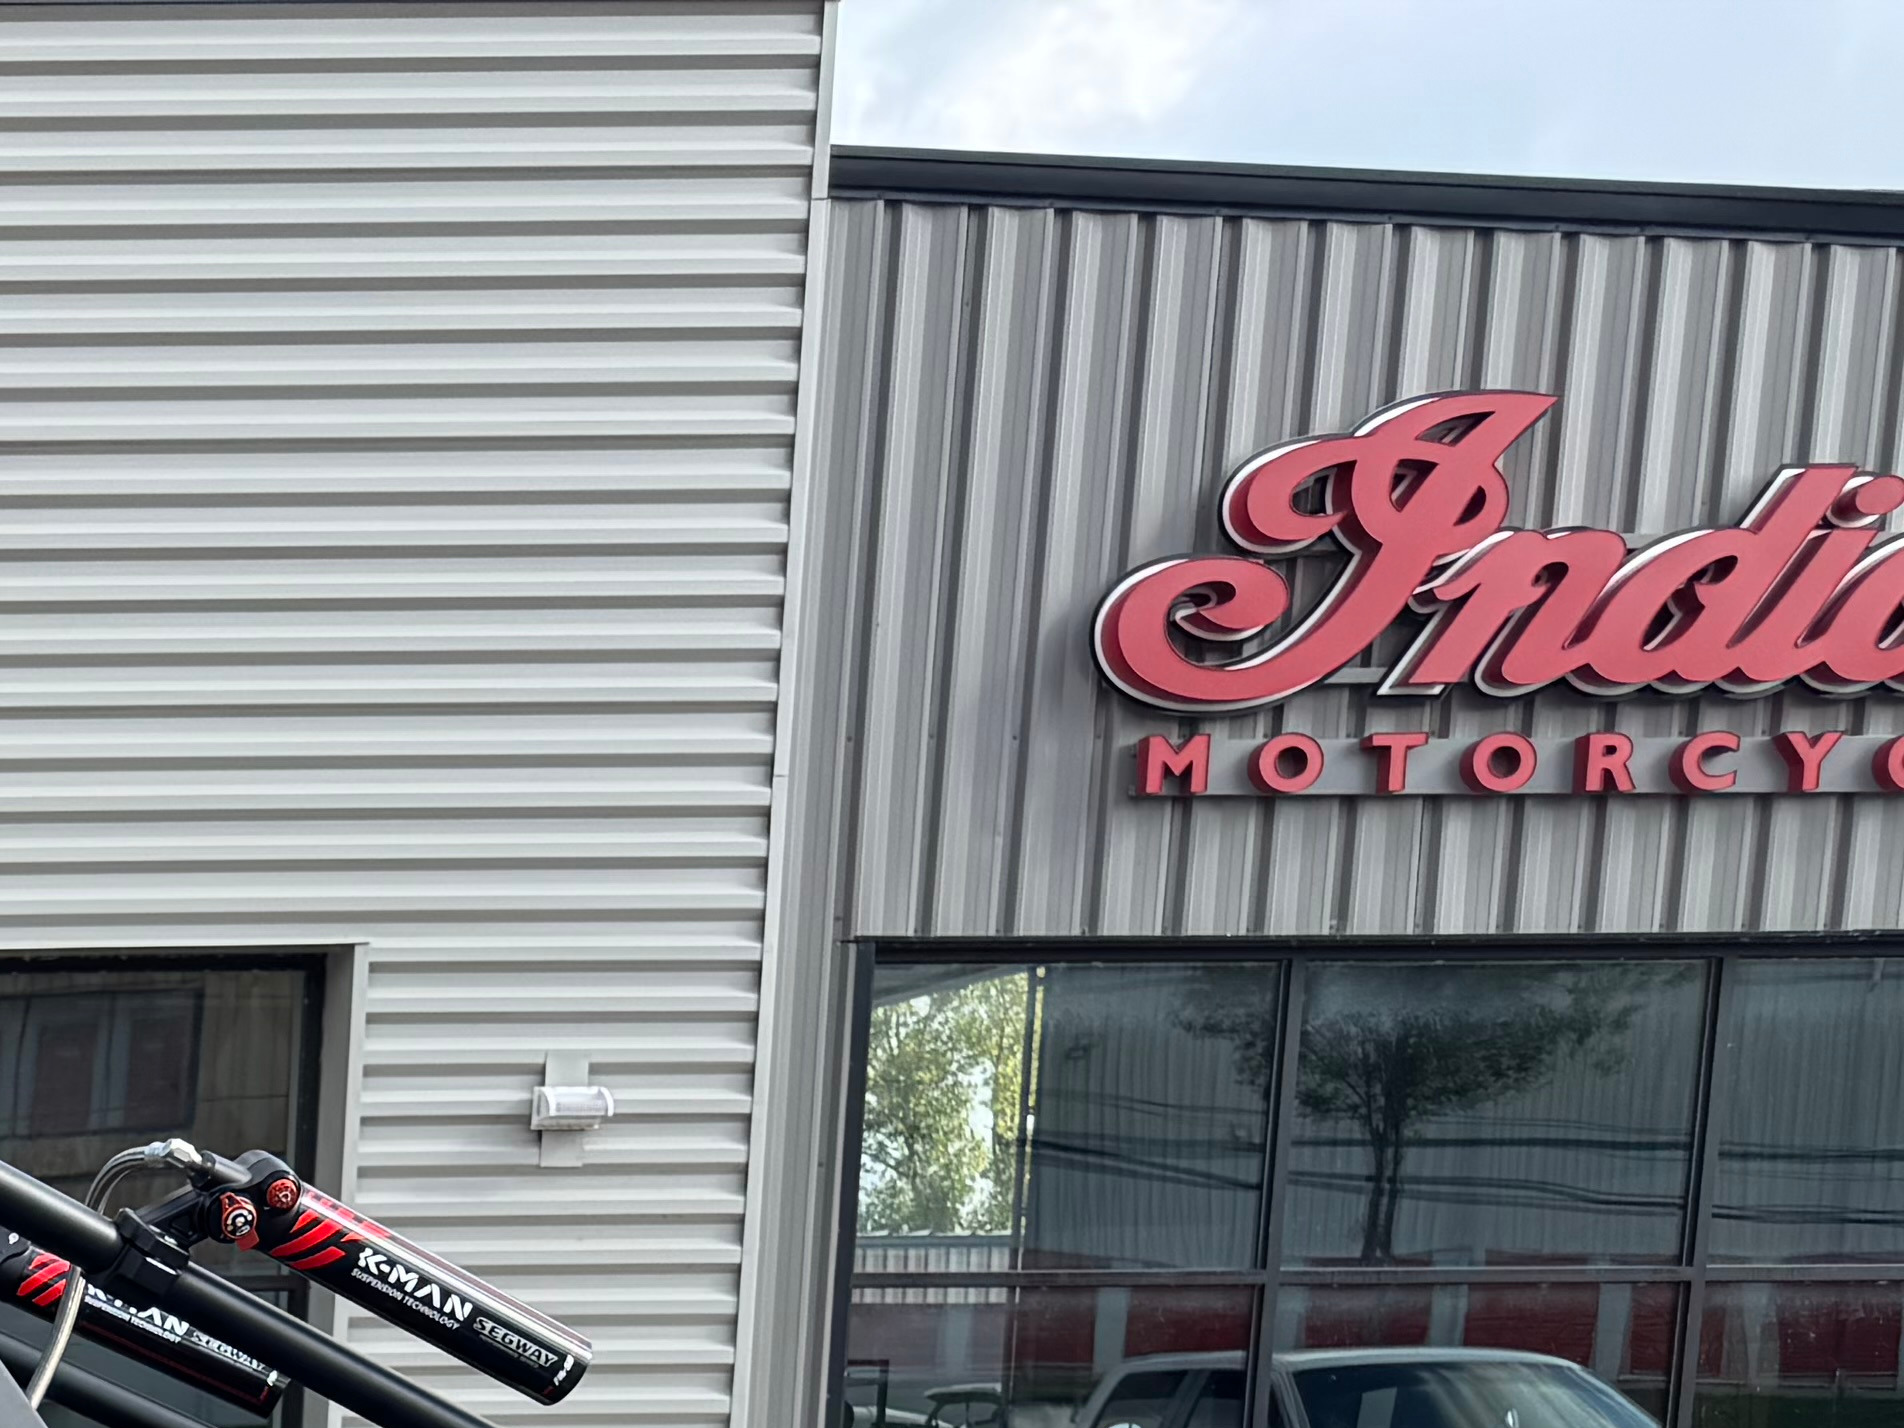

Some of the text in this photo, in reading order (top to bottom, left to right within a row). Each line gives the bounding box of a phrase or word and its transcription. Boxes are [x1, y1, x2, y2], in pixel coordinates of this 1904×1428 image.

[351, 1267, 460, 1330] SUSPENSION TECHNOLOGY
[358, 1247, 474, 1322] K-MAN
[473, 1316, 559, 1368] SEGWAY
